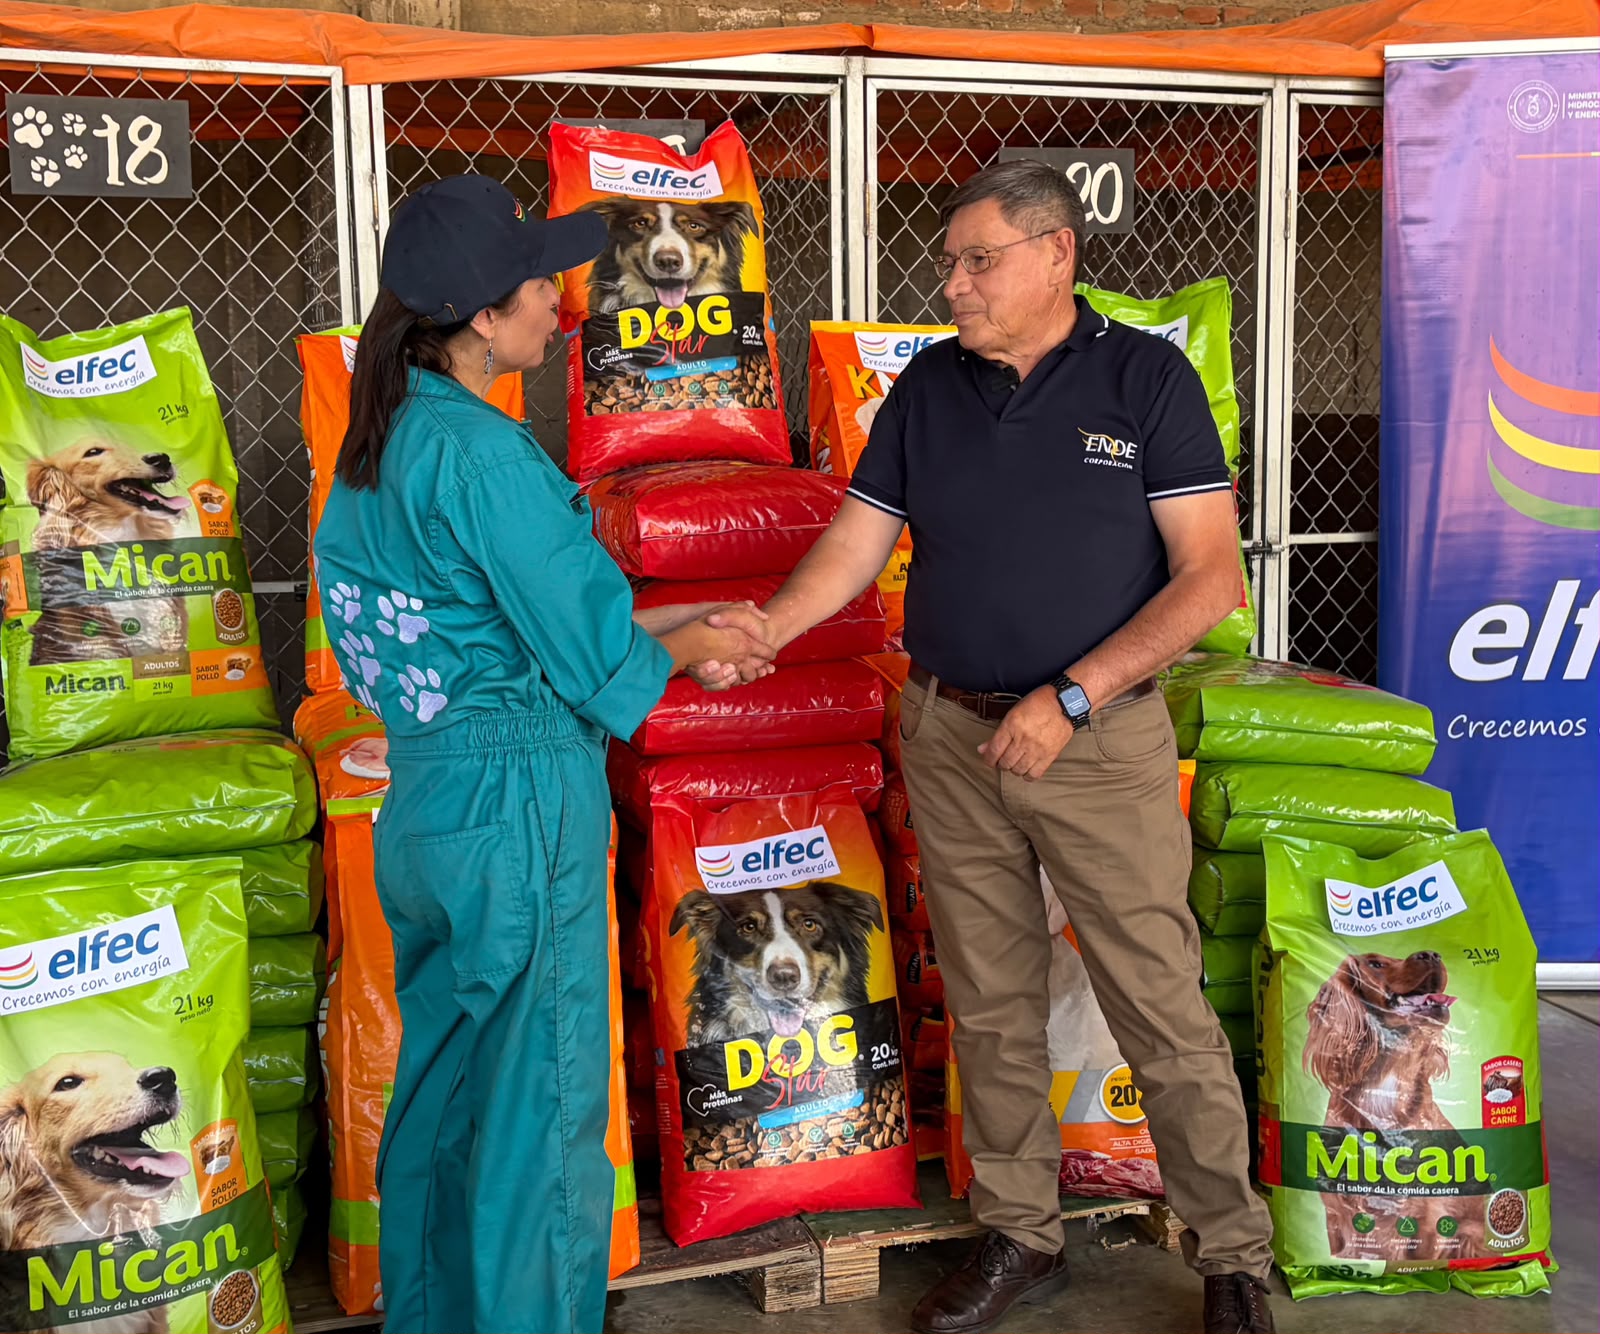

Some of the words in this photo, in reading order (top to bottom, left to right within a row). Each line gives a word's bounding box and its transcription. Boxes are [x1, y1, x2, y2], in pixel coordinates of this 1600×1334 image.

[1567, 111, 1573, 119] Y
[92, 113, 169, 187] 18
[632, 168, 706, 189] elfec
[595, 180, 647, 194] Crecemos
[650, 188, 669, 196] con
[673, 188, 712, 198] energía
[1066, 161, 1124, 225] 20
[618, 295, 734, 350] DOG
[742, 325, 756, 339] 20
[605, 349, 620, 358] Más
[650, 321, 711, 366] Star
[55, 349, 137, 386] elfec
[599, 352, 633, 365] Proteínas
[676, 360, 707, 370] ADULTO
[27, 375, 75, 395] Crecemos
[79, 386, 101, 395] con
[105, 370, 146, 391] energía
[158, 404, 173, 420] 21
[175, 404, 189, 414] kg
[1085, 436, 1138, 460] ENDE
[82, 543, 232, 591] Mican
[115, 590, 123, 598] El
[124, 587, 147, 598] sabor
[194, 584, 214, 592] casera
[219, 630, 246, 641] ADULTOS
[144, 660, 180, 671] ADULTOS
[196, 664, 220, 673] SABOR
[45, 673, 126, 697] Mican
[153, 682, 161, 690] 21
[163, 681, 173, 690] kg
[196, 673, 220, 681] POLLO
[1447, 714, 1587, 739] Crecemos
[742, 836, 825, 873] elfec
[707, 876, 762, 890] Crecemos
[767, 872, 787, 883] con
[792, 859, 835, 877] energía
[1357, 876, 1439, 919] elfec
[1333, 918, 1377, 933] Crecemos
[1381, 919, 1402, 930] con
[1406, 901, 1452, 926] energía
[48, 923, 161, 980] elfec
[1463, 948, 1481, 959] 21
[1484, 948, 1499, 959] kg
[2, 984, 75, 1010] Crecemos
[81, 977, 108, 992] con
[114, 954, 171, 983] energía
[172, 994, 193, 1015] 21
[197, 992, 214, 1009] kg
[180, 1013, 196, 1023] peso
[196, 1006, 211, 1017] neto
[724, 1014, 858, 1091] DOG
[871, 1043, 890, 1062] 20
[761, 1054, 830, 1109] Star
[702, 1094, 743, 1110] Proteínas
[710, 1089, 727, 1100] Más
[1110, 1084, 1137, 1107] 20
[794, 1099, 829, 1114] ADULTO
[1491, 1105, 1517, 1115] SABOR
[1491, 1115, 1518, 1125] CARNE
[1306, 1131, 1490, 1184] Mican
[211, 1177, 237, 1197] SABOR
[1336, 1184, 1346, 1192] El
[1347, 1184, 1372, 1193] sabor
[1374, 1185, 1385, 1194] de
[1385, 1185, 1394, 1194] la
[1396, 1185, 1429, 1195] comida
[1431, 1187, 1459, 1195] casera
[212, 1188, 238, 1208] POLLO
[1488, 1235, 1525, 1248] ADULTOS
[27, 1223, 241, 1311] Mican
[68, 1309, 79, 1319] El
[81, 1304, 111, 1317] sabor
[114, 1299, 128, 1312] de
[129, 1296, 139, 1308] la
[141, 1287, 179, 1305] comida
[181, 1276, 212, 1295] casera
